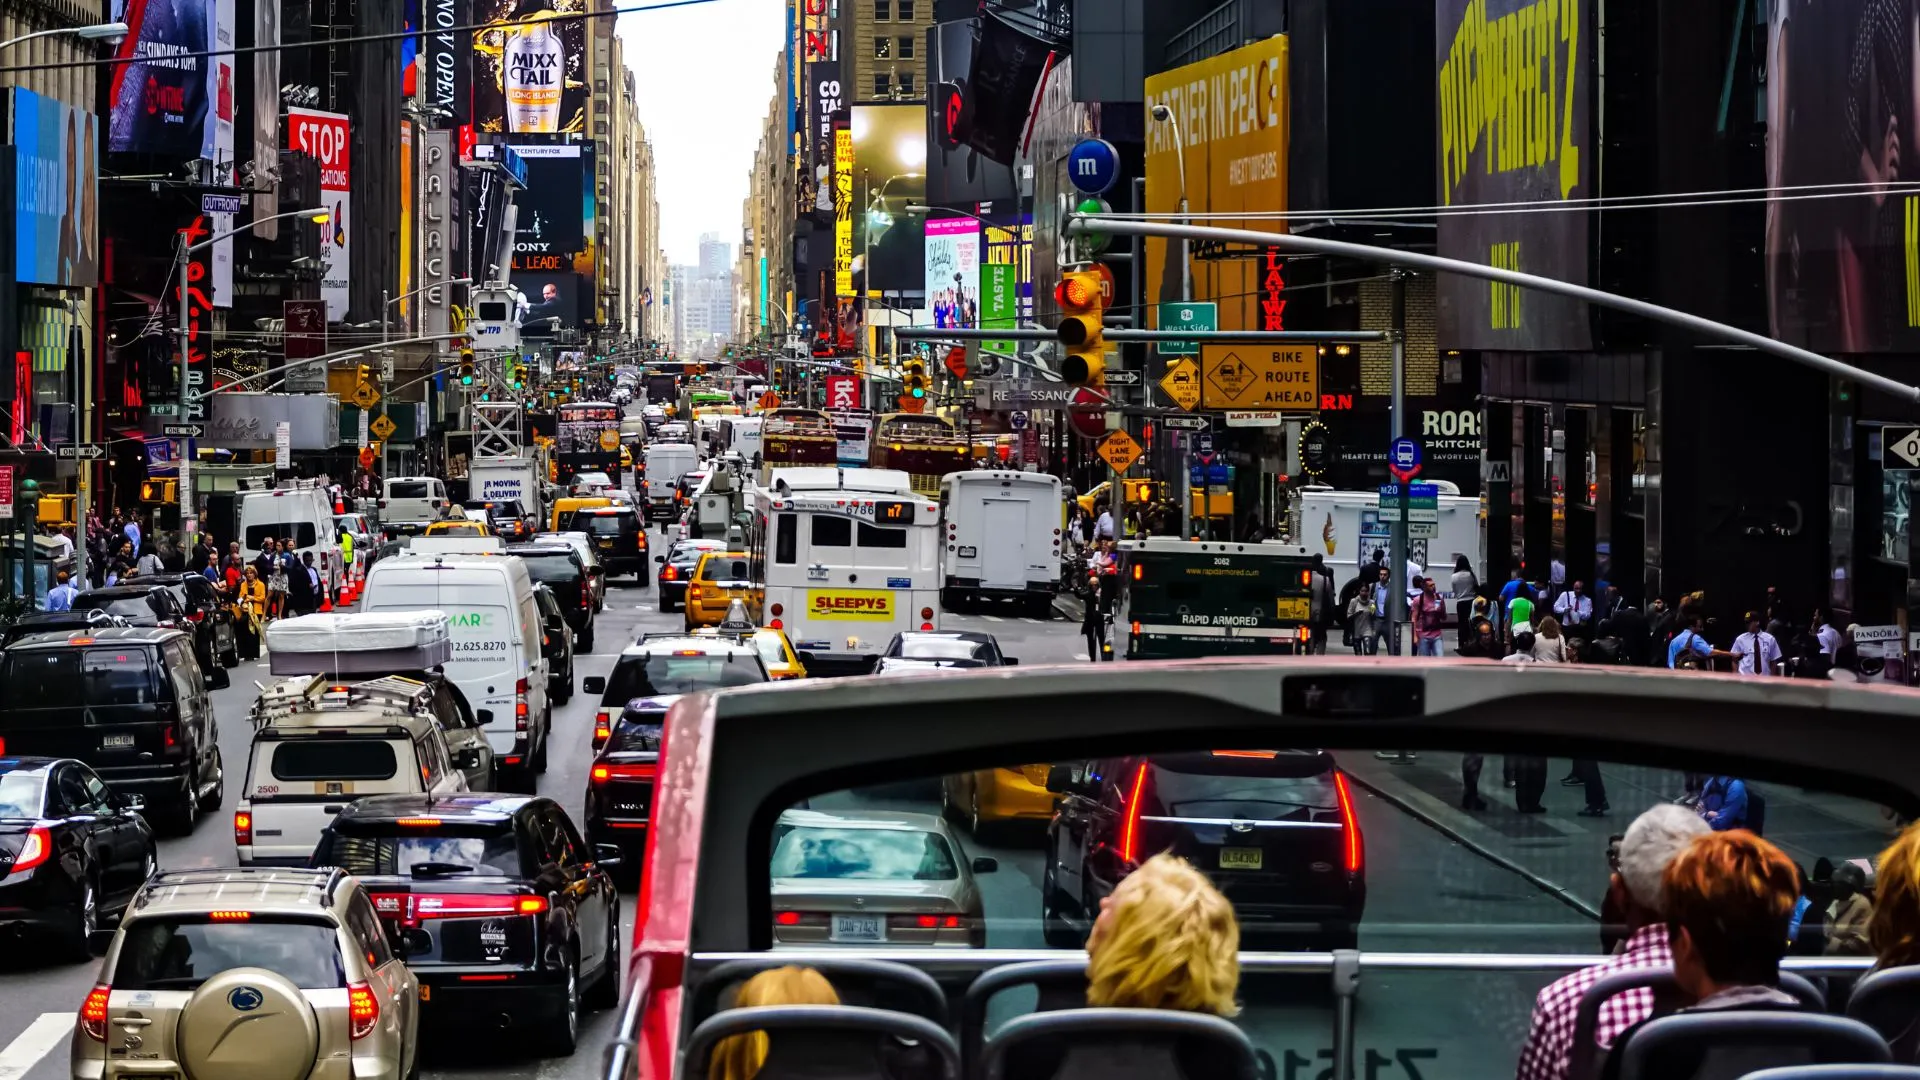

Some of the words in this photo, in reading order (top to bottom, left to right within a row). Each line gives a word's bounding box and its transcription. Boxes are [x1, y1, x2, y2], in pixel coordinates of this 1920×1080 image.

[511, 53, 557, 68] MIXX
[510, 66, 556, 85] TAIL
[512, 91, 531, 99] LONG
[532, 91, 556, 99] ISLAND
[1146, 84, 1207, 156] PARTNER
[1211, 76, 1226, 141] IN
[1229, 57, 1279, 135] PEACE
[299, 121, 345, 165] STOP
[1078, 156, 1097, 175] m
[203, 197, 240, 213] OUTFRONT
[427, 146, 443, 304] PALACE
[993, 266, 1005, 312] TASTE
[1272, 352, 1303, 363] BIKE
[1265, 371, 1311, 383] ROUTE
[187, 370, 204, 418] BAR
[1264, 391, 1313, 403] AHEAD
[1169, 419, 1183, 427] ONE
[1189, 419, 1204, 427] WAY
[1109, 437, 1130, 445] RIGHT
[1109, 447, 1130, 455] LANE
[1110, 456, 1130, 464] ENDS
[484, 480, 492, 488] JR
[493, 479, 521, 488] MOVING
[490, 489, 522, 498] DELIVERY
[1380, 485, 1398, 495] M20
[846, 505, 874, 515] 6786
[1182, 614, 1210, 625] RAPID
[1212, 615, 1258, 626] ARMORED
[257, 785, 279, 793] 2500
